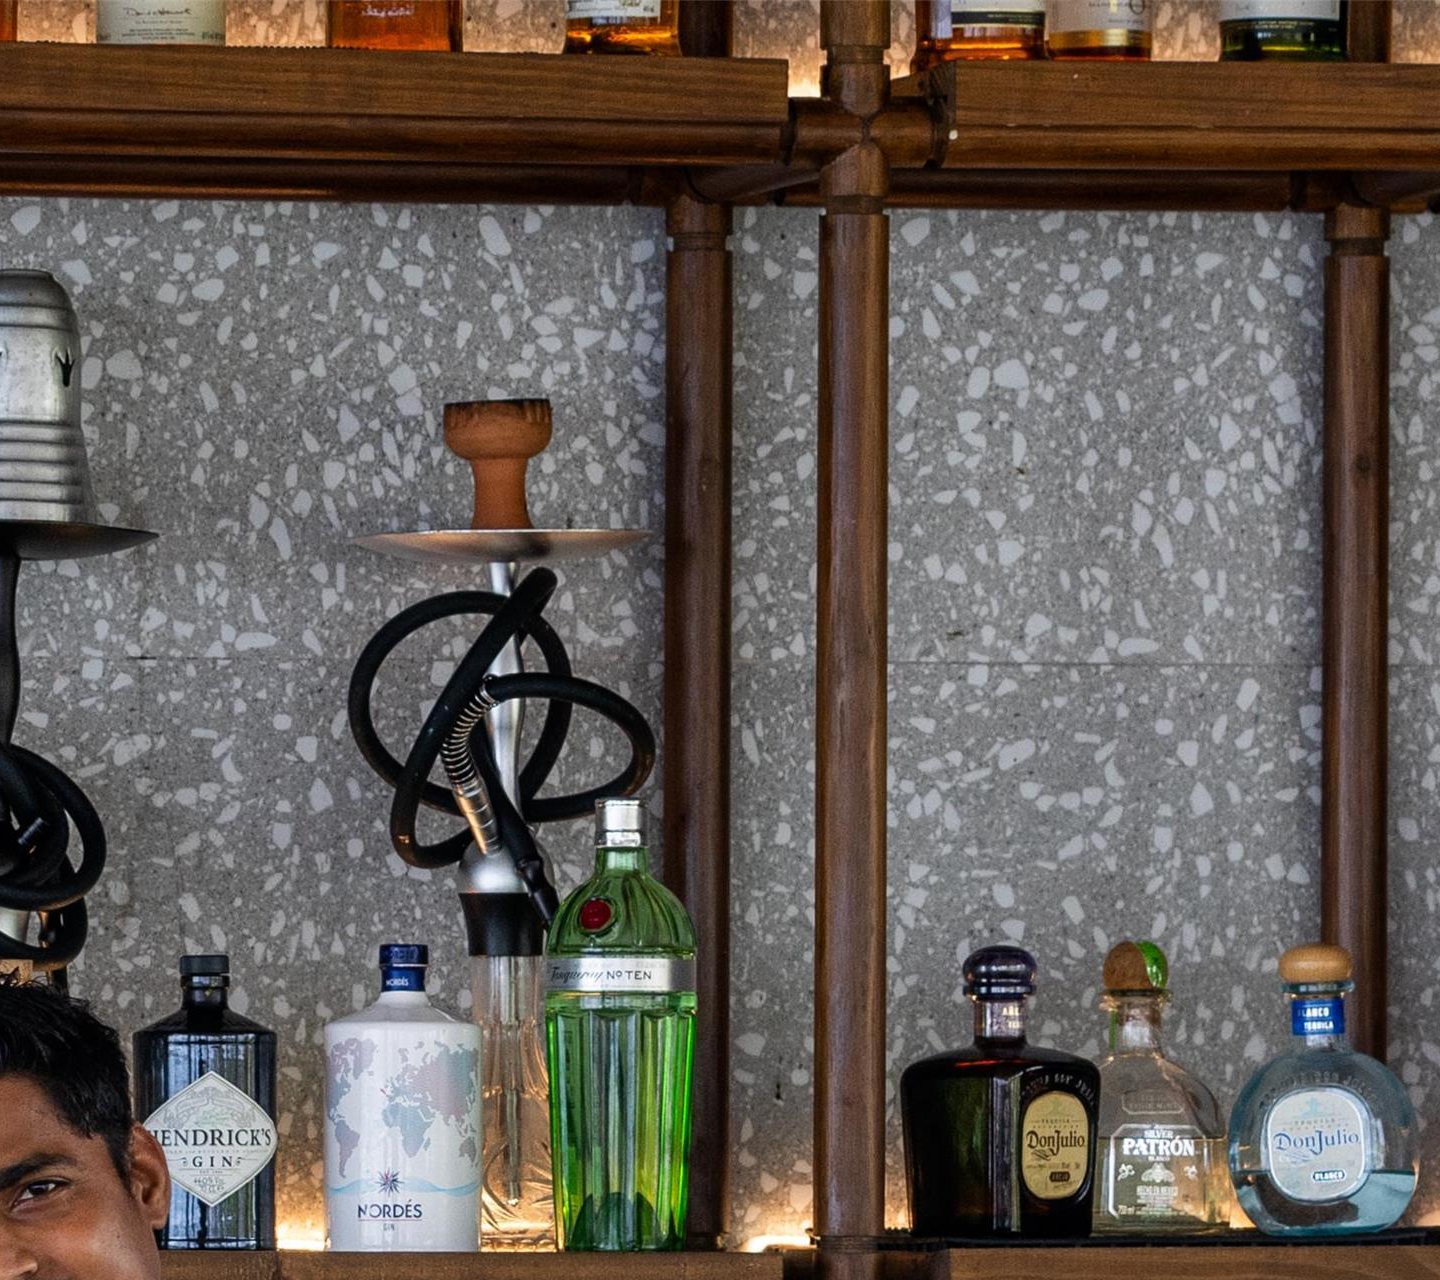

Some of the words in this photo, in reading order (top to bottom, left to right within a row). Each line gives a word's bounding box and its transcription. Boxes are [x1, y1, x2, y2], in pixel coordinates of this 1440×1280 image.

[627, 970, 652, 980] TEN
[1144, 1129, 1174, 1139] SILVER
[1121, 1136, 1196, 1157] PATRÓN
[192, 1155, 233, 1168] GIN
[357, 1199, 423, 1218] NORDÉS
